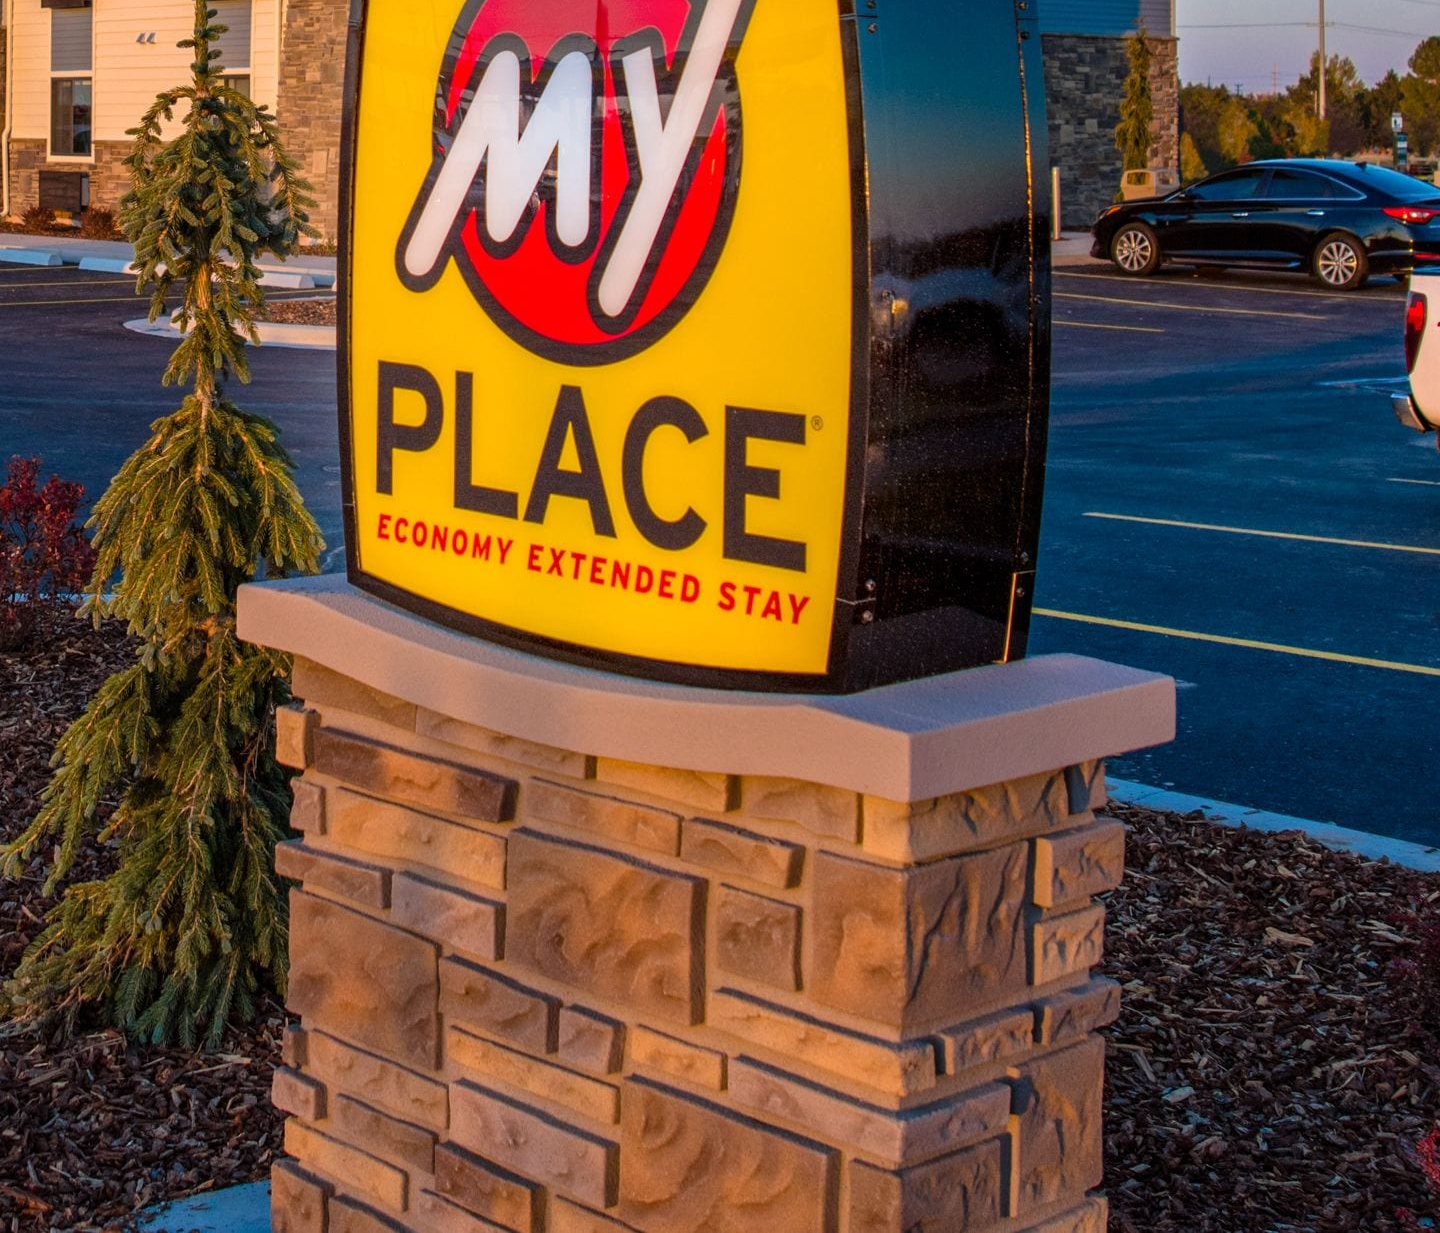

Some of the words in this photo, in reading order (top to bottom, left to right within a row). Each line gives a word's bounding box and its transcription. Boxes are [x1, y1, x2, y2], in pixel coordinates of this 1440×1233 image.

[375, 360, 807, 572] PLACE
[377, 513, 514, 564] ECONOMY
[527, 544, 701, 604] EXTENDED
[717, 582, 811, 625] STAY
